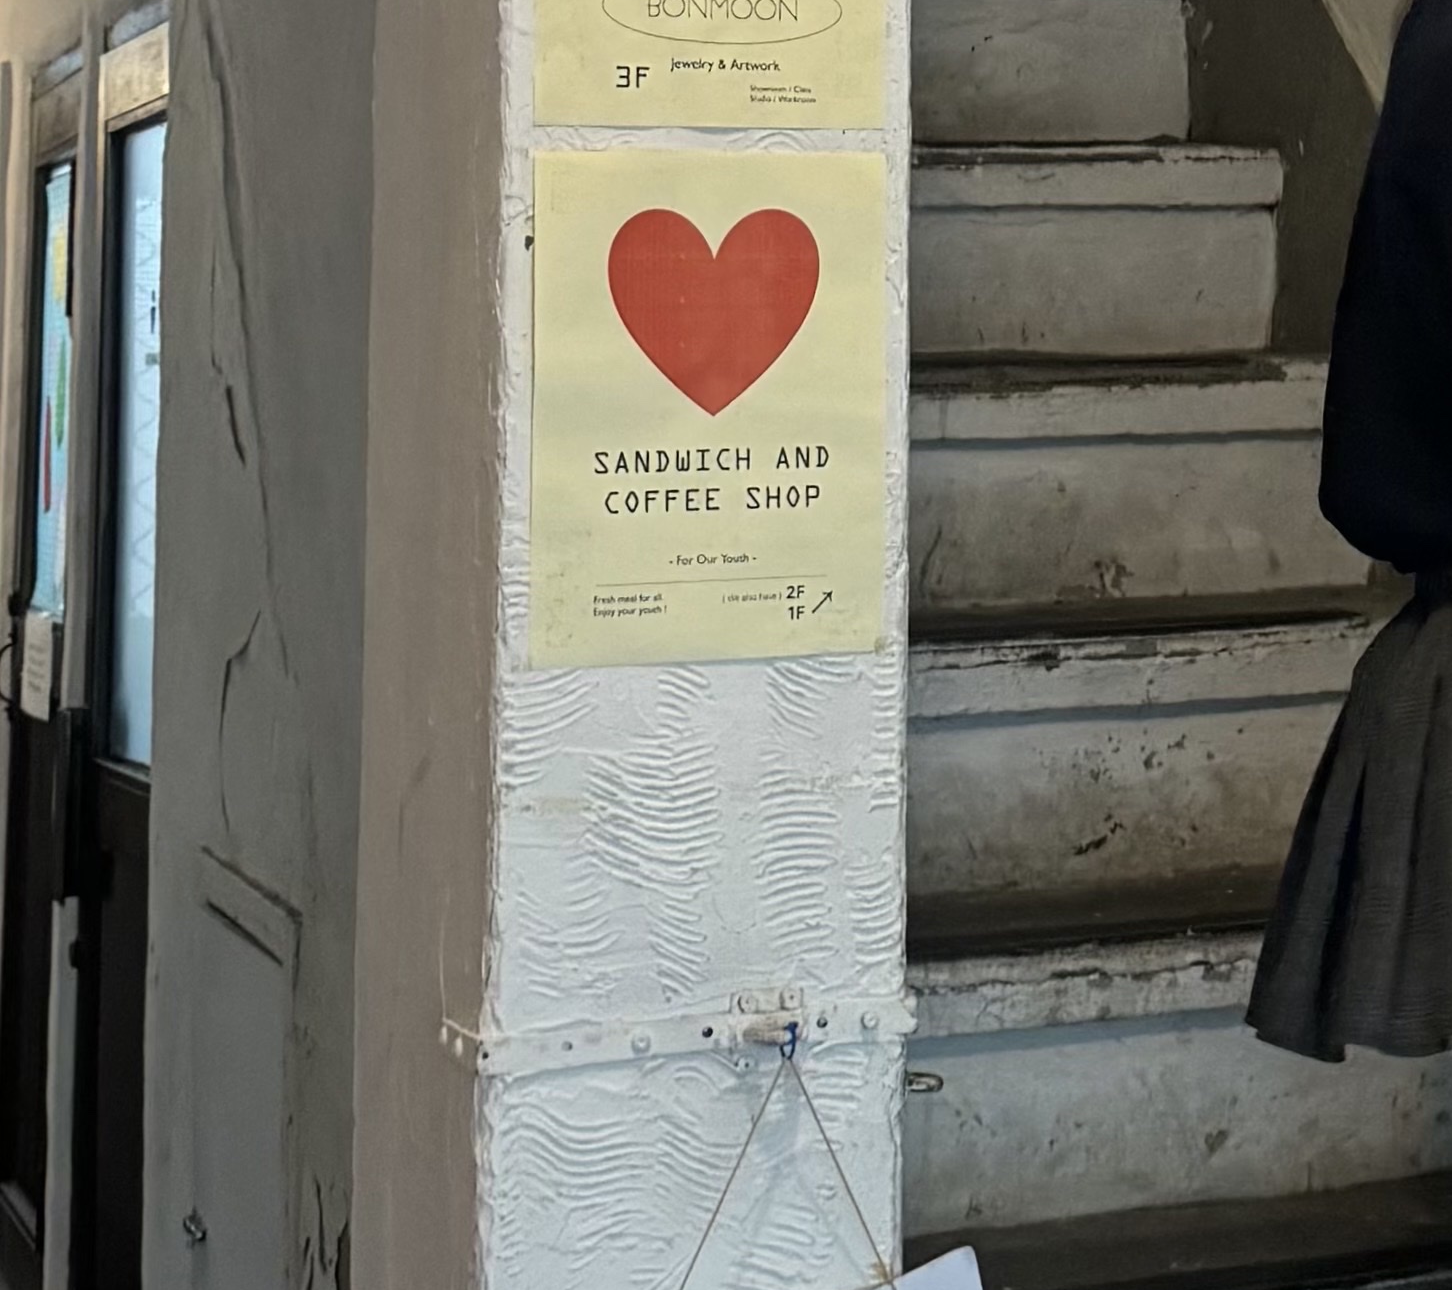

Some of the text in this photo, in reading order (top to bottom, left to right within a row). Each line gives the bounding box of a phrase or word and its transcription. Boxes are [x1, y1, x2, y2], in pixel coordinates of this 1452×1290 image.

[718, 58, 726, 71] &
[730, 58, 782, 73] Artwork
[616, 65, 651, 89] 3F
[594, 445, 830, 475] SANDWICH AND
[605, 484, 821, 515] COFFEE SHOP
[676, 555, 694, 566] For
[696, 553, 718, 565] Our
[721, 553, 750, 565] Youth
[785, 585, 806, 600] 2F
[787, 605, 806, 621] 1F
